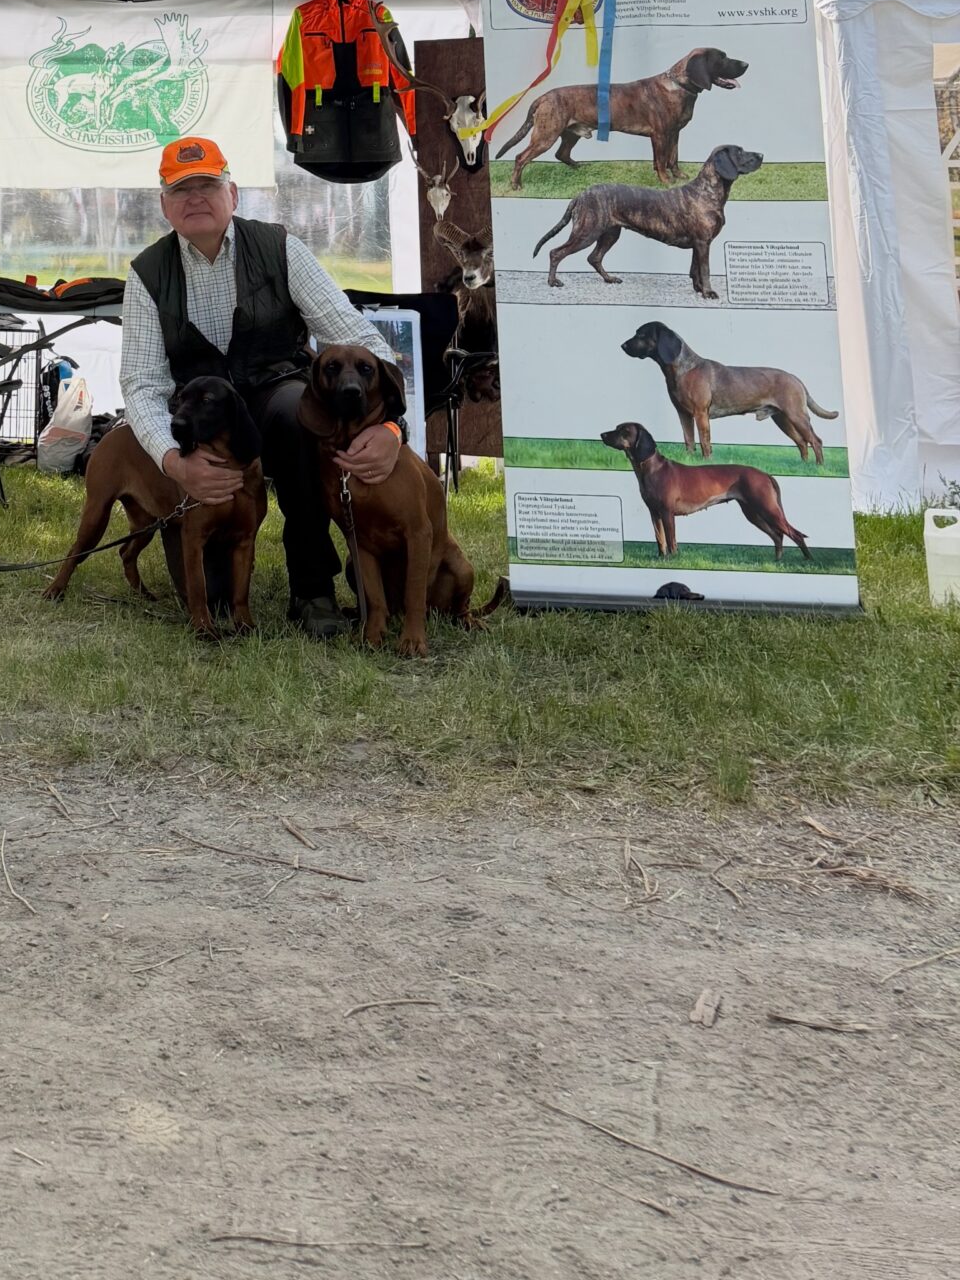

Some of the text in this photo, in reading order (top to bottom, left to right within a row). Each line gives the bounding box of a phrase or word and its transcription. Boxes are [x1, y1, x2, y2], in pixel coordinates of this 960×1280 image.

[717, 6, 798, 19] www.svshk.org
[33, 86, 61, 132] SVENSKA
[173, 79, 201, 127] KLUBBEN
[62, 127, 155, 145] SCHWEISSHUND
